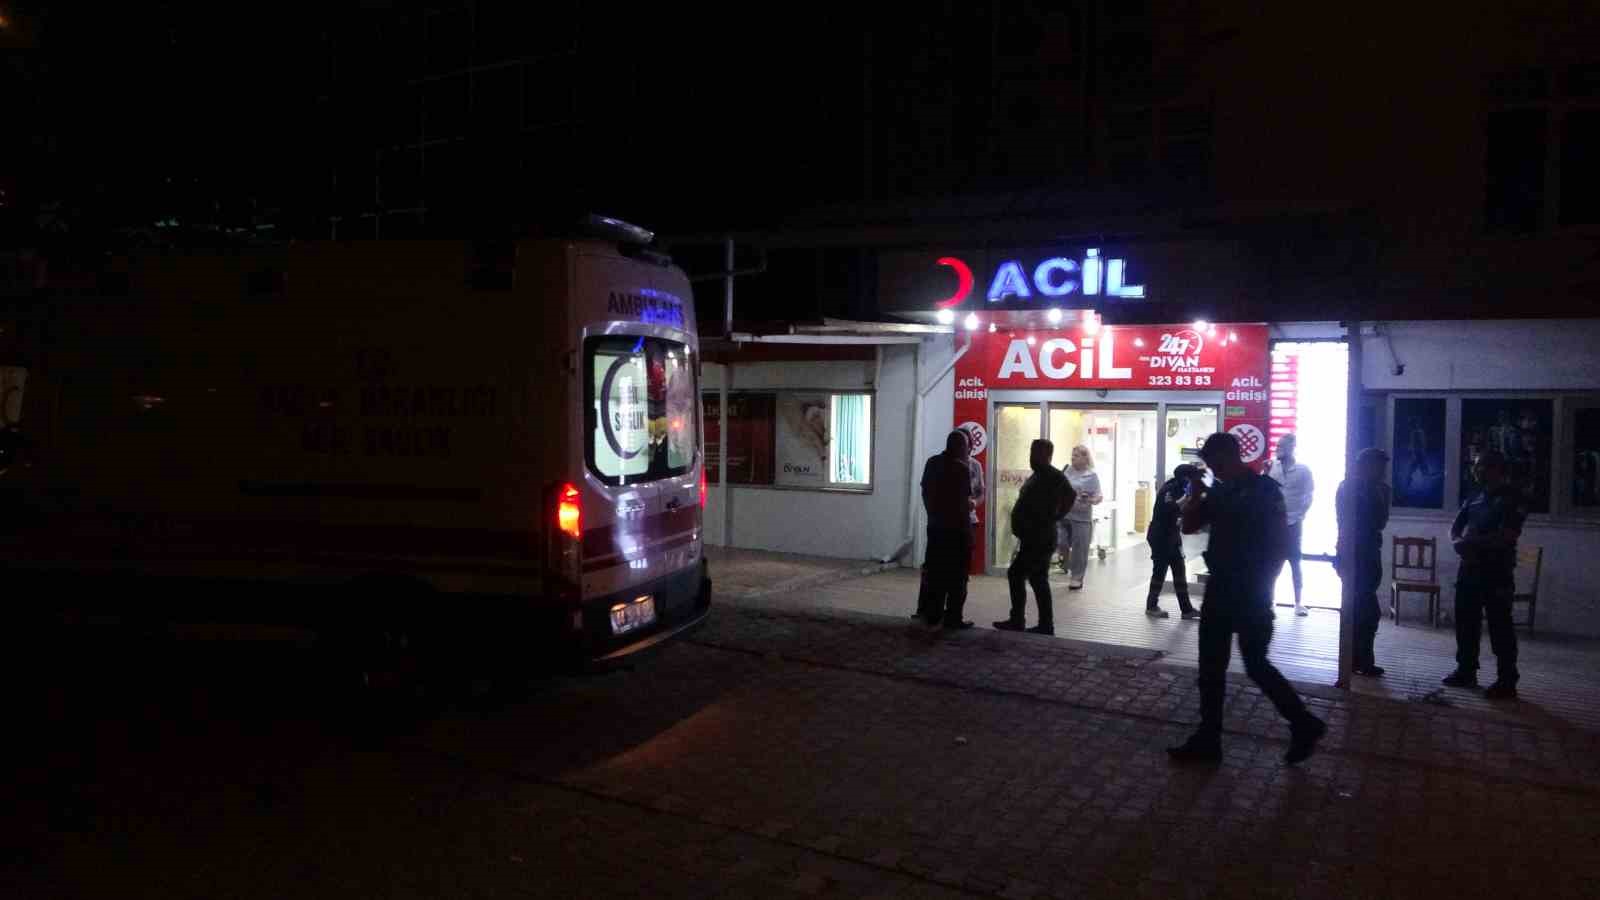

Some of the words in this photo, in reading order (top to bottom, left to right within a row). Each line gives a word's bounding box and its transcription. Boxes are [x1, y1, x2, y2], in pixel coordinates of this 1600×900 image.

[988, 248, 1145, 302] ACİL
[959, 377, 984, 387] ACİL
[1149, 375, 1171, 386] 323
[1175, 375, 1191, 386] 83
[1195, 375, 1211, 386] 83
[1232, 376, 1263, 387] ACİL
